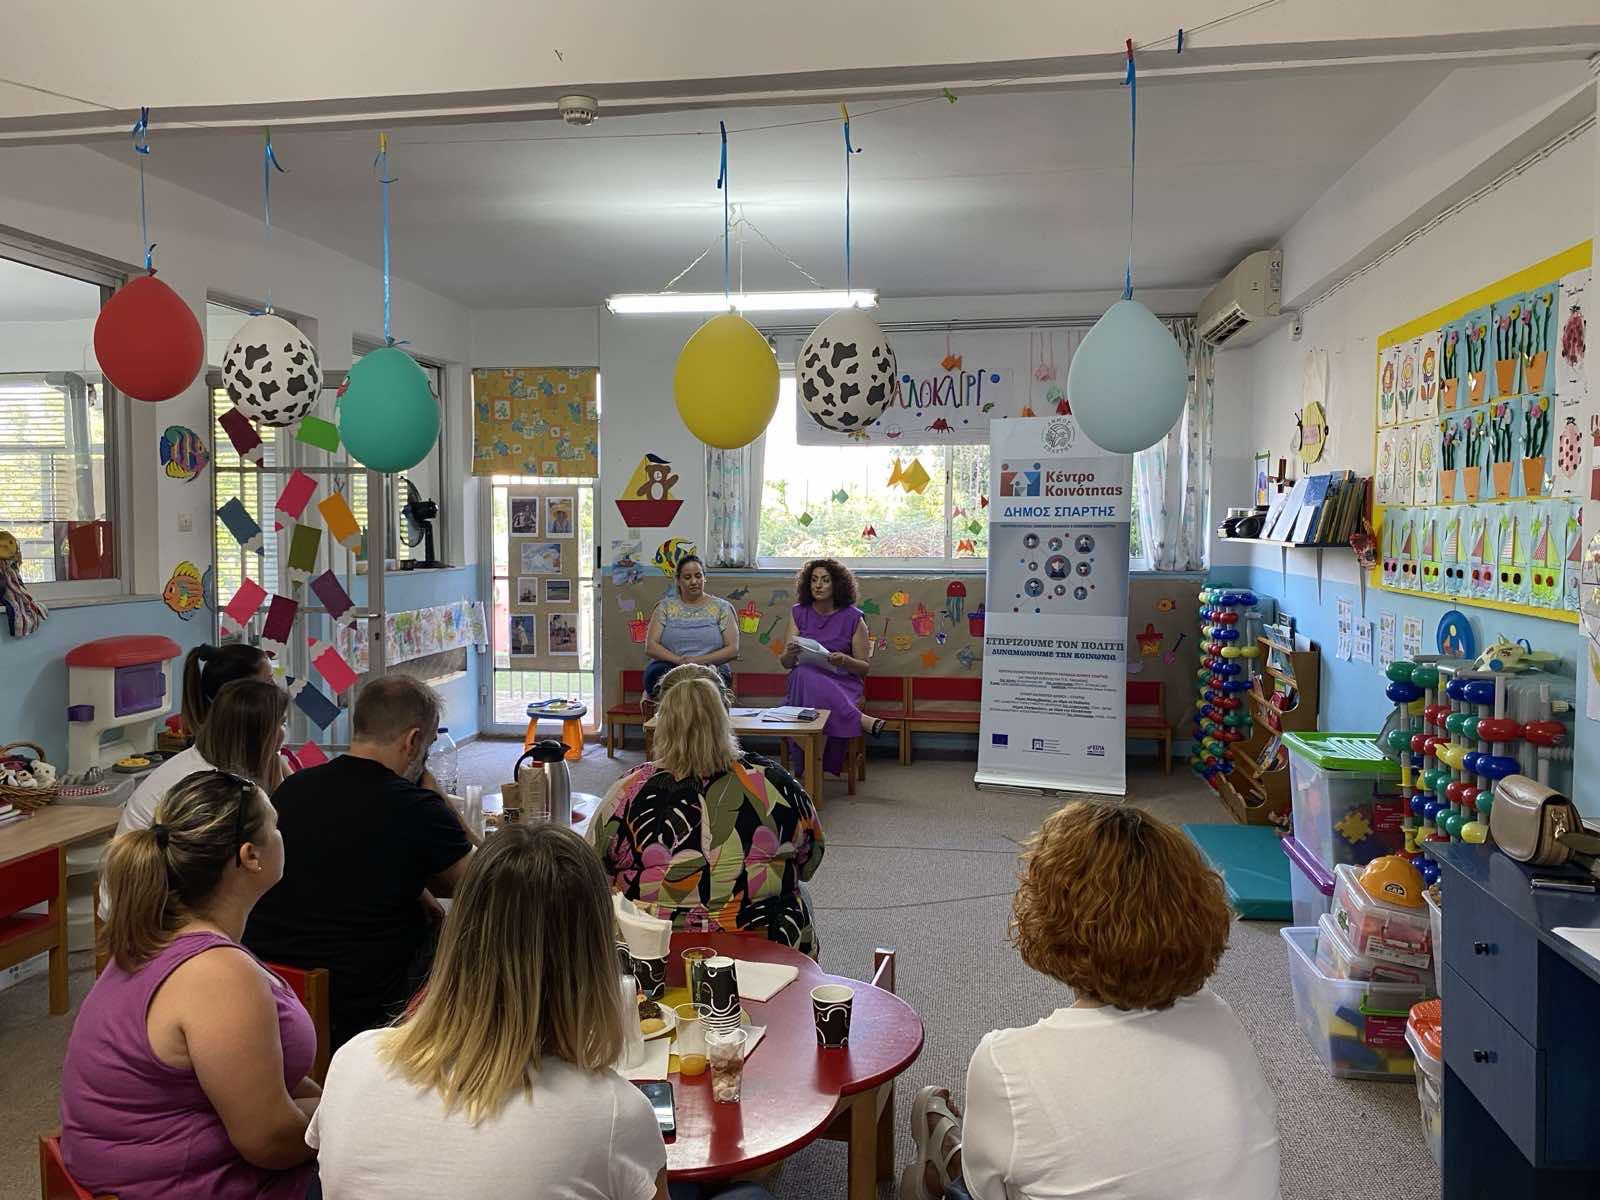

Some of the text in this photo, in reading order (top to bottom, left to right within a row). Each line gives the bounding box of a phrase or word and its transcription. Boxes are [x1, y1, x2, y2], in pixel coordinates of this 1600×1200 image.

[890, 369, 987, 409] ΑΛΟΚΑΙΡΙ
[1046, 470, 1095, 485] Κέντρο
[1045, 485, 1123, 497] Κοινότητας
[1004, 506, 1116, 517] ΔΗΜΟΣ ΣΠΑΡΤΗΣ
